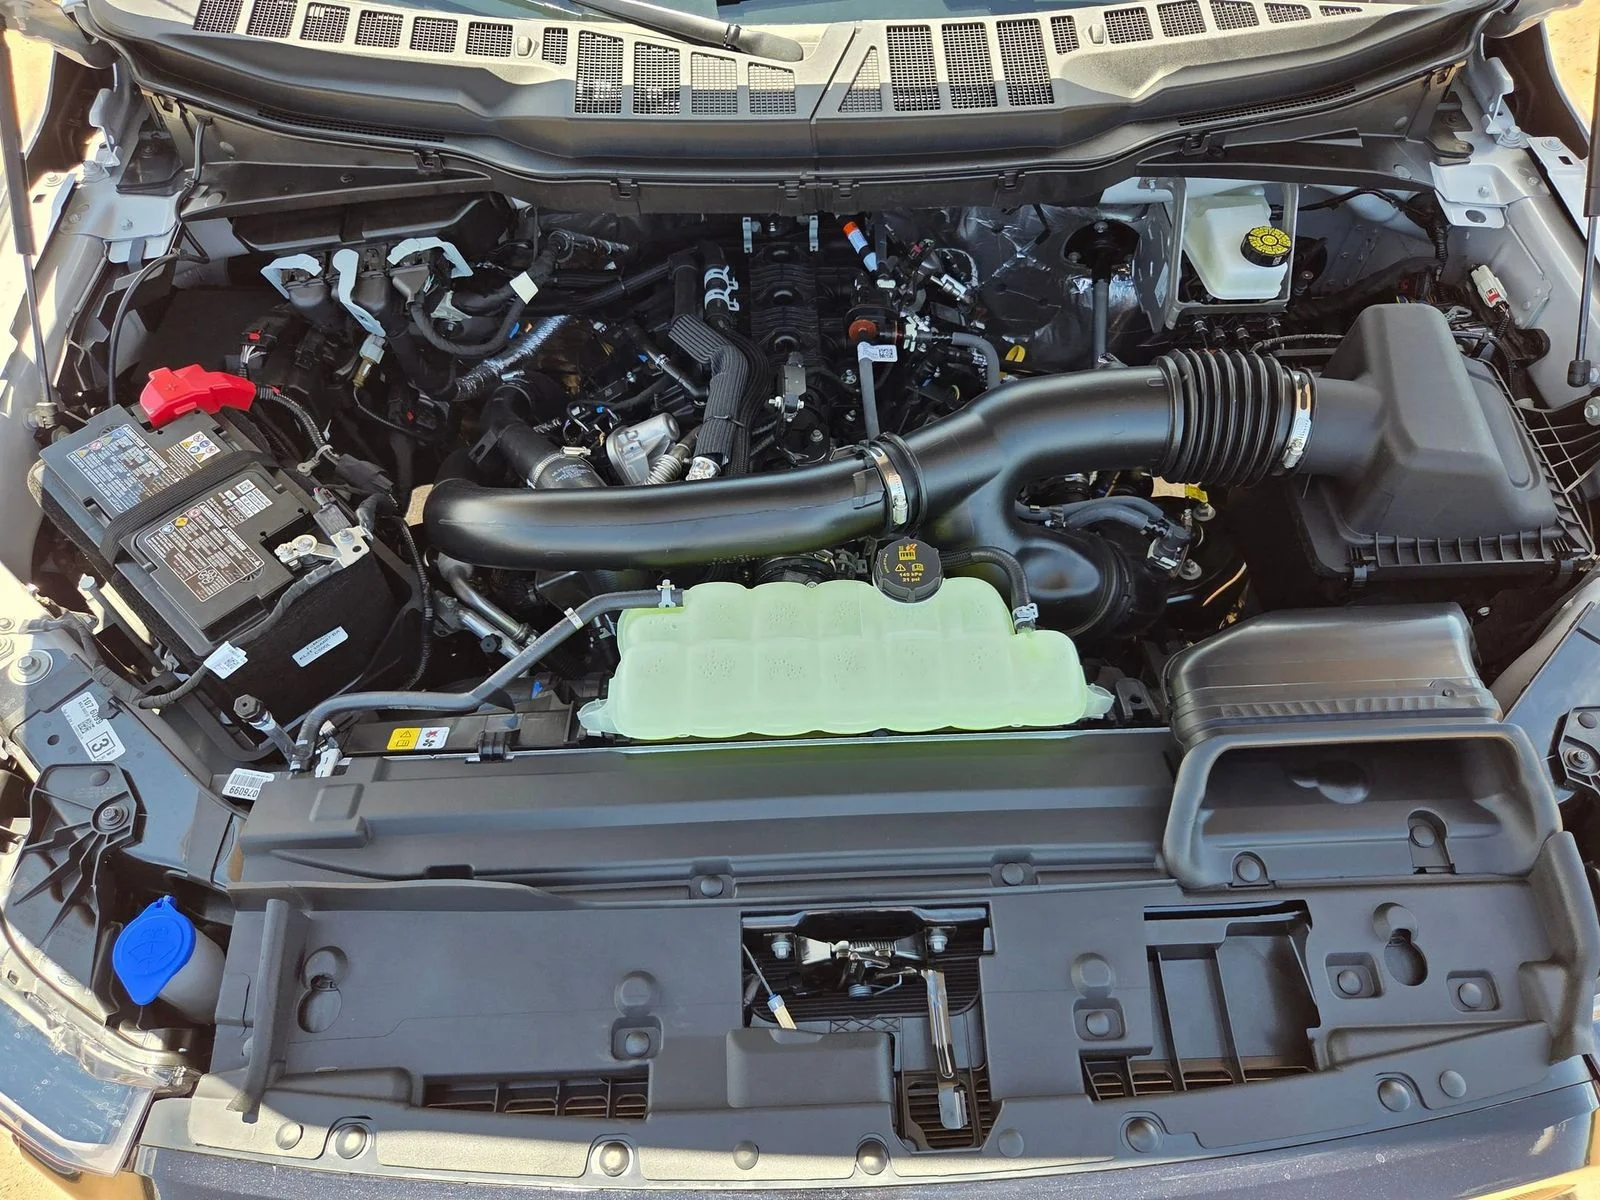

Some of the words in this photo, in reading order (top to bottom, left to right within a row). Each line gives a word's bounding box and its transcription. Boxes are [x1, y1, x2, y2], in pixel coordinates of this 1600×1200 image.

[82, 697, 94, 709] 107
[92, 738, 109, 752] 3
[228, 785, 259, 798] 076099
